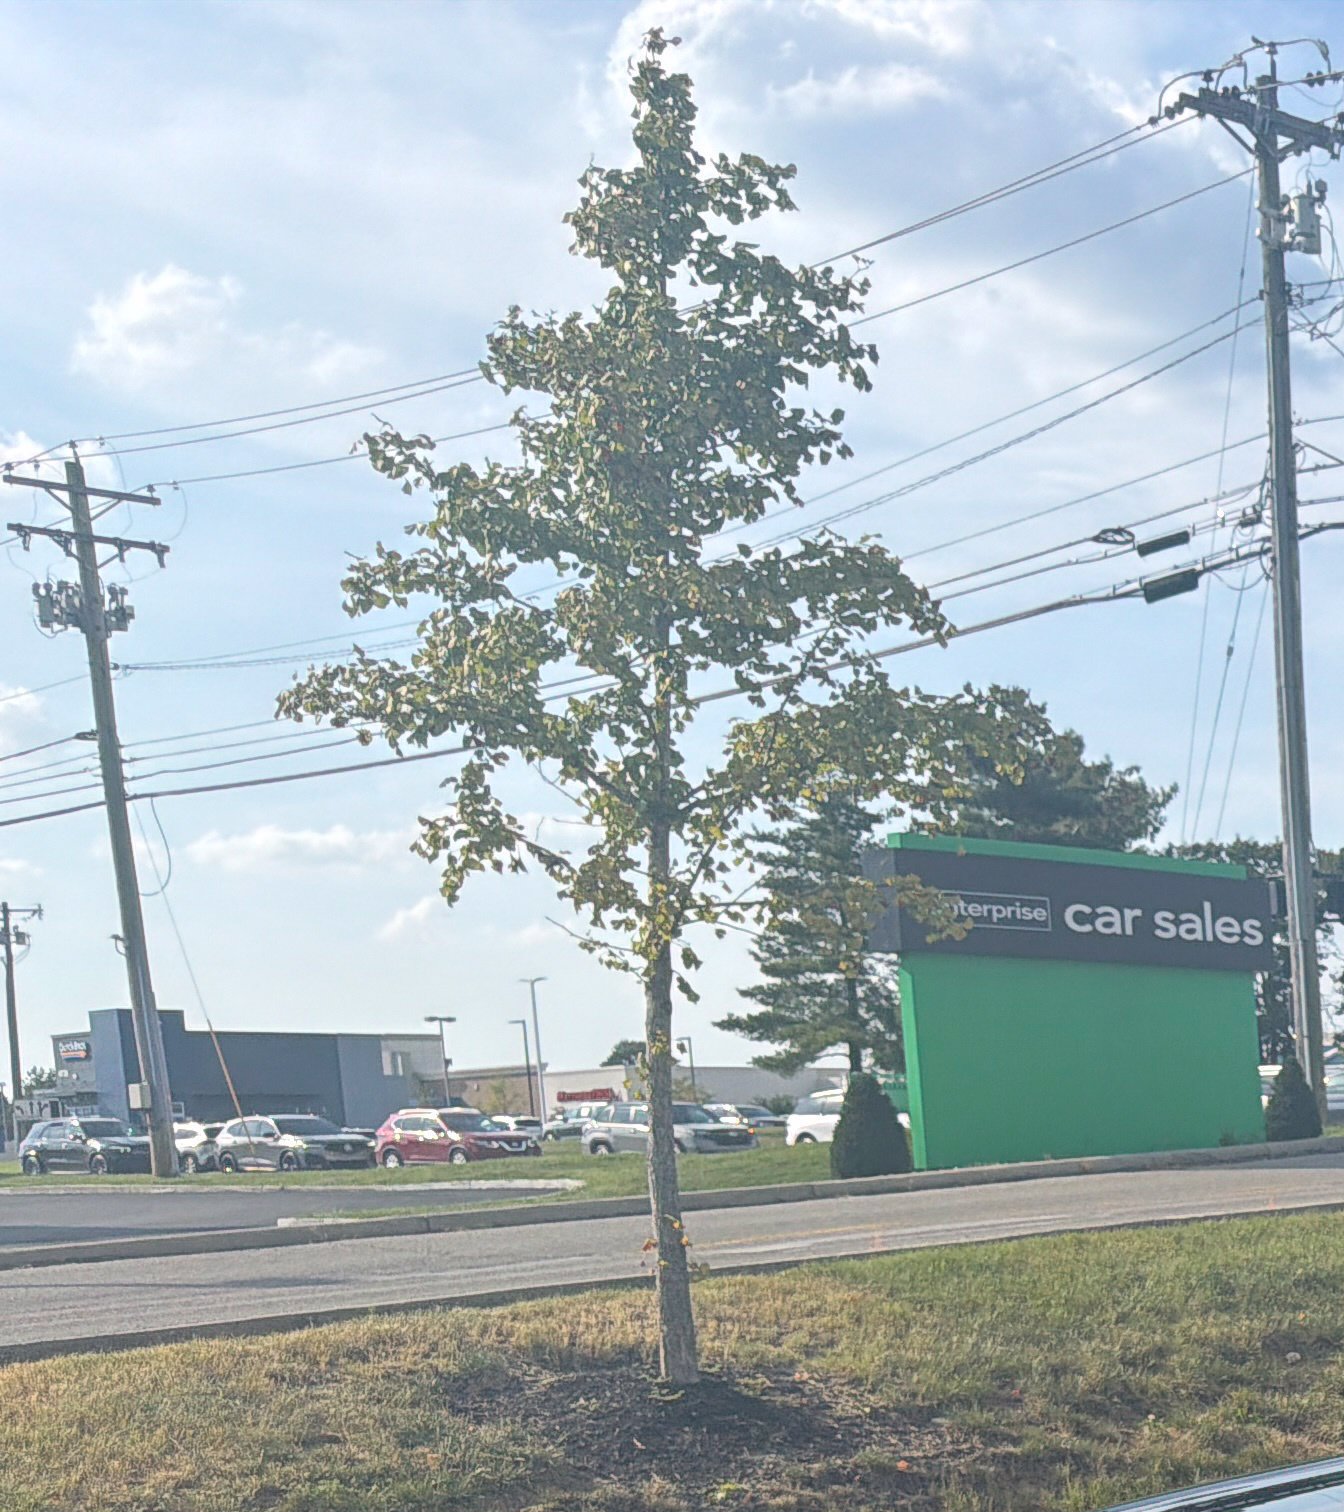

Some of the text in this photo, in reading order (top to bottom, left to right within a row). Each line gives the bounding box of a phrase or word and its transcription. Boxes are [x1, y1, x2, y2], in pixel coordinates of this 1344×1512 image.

[941, 901, 1264, 946] terprise car sales
